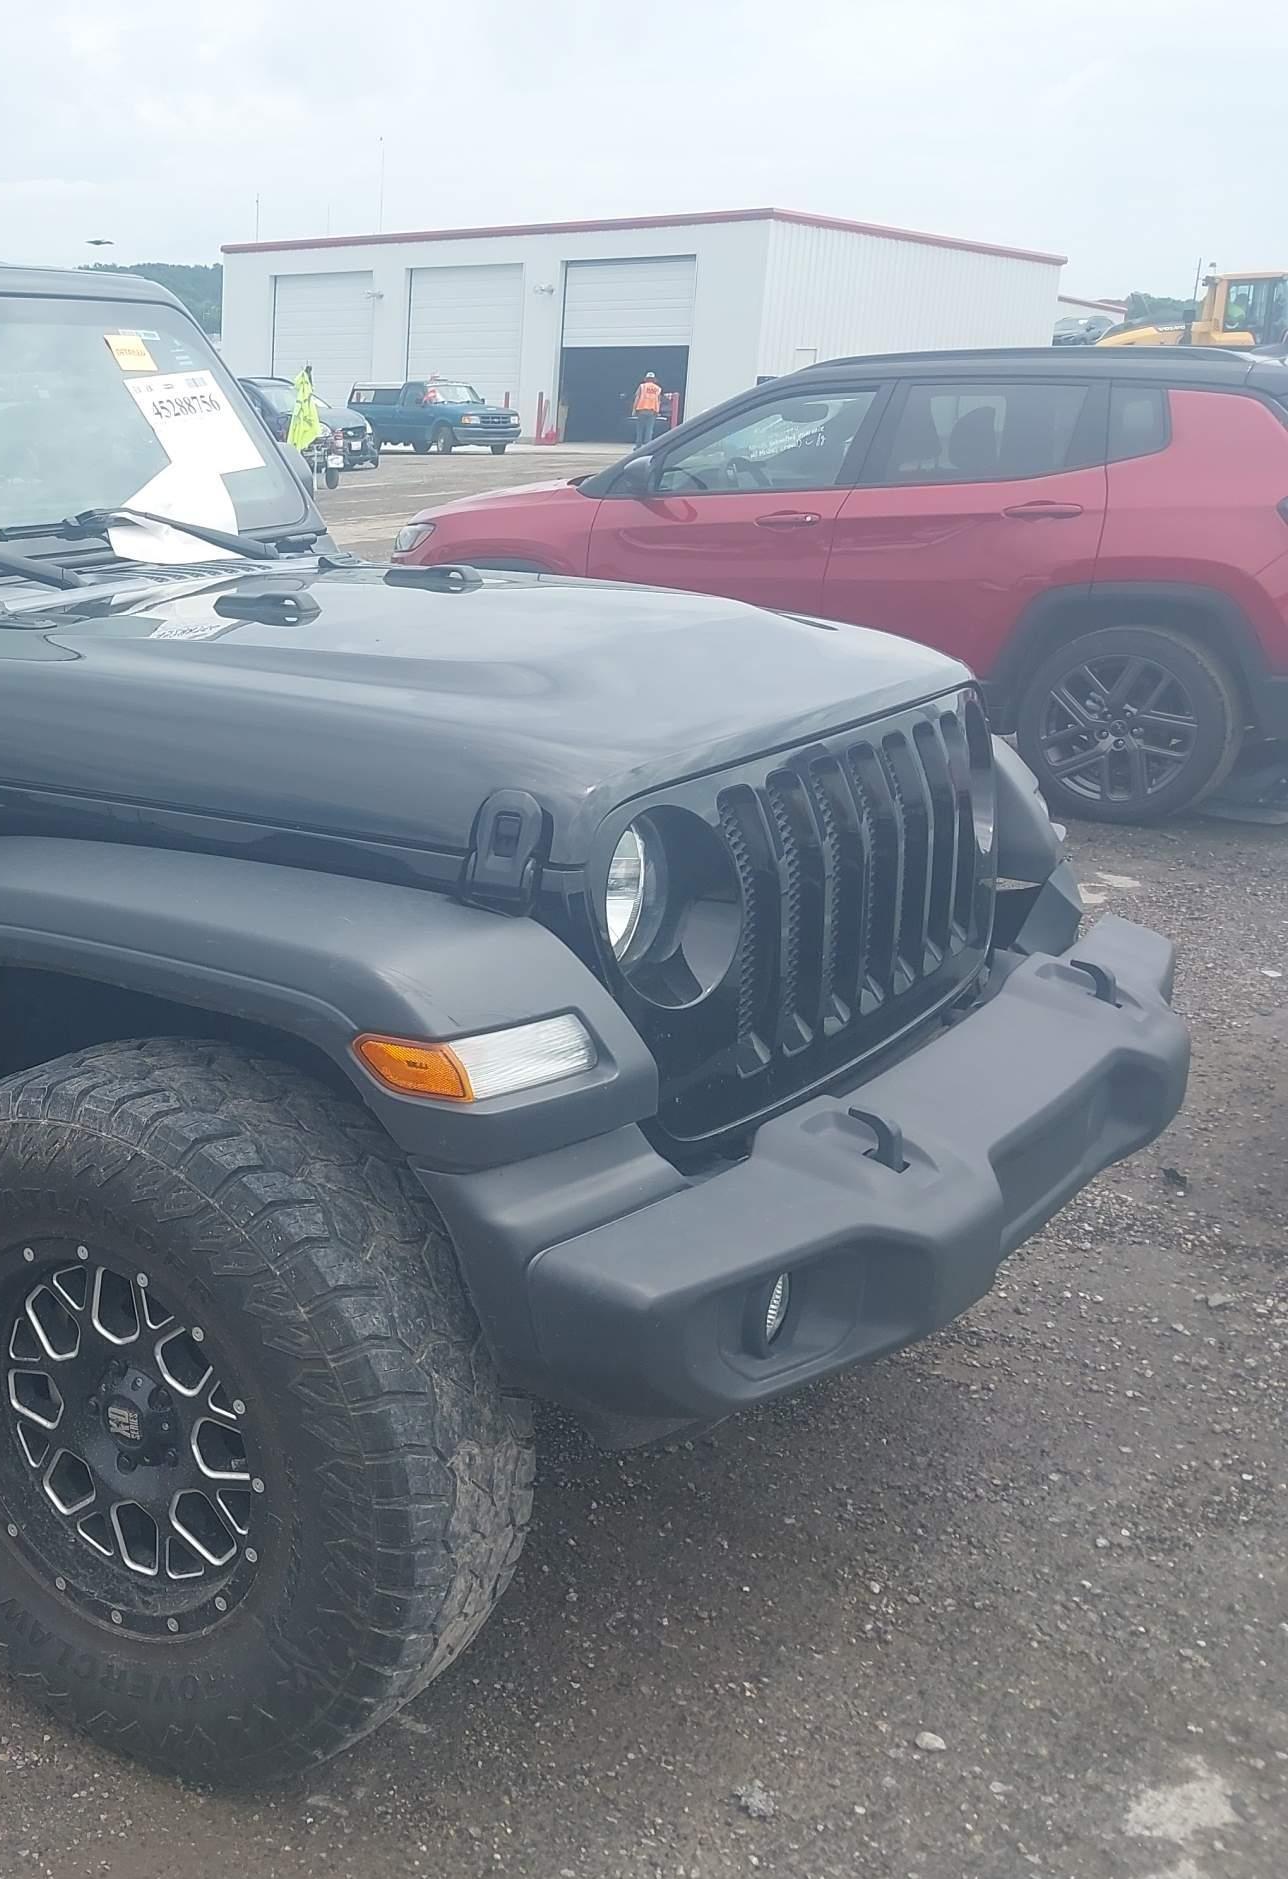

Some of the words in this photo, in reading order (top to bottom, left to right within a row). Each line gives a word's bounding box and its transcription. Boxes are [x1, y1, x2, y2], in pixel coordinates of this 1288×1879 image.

[152, 392, 221, 420] 45288756
[108, 1407, 130, 1438] XD
[128, 1412, 140, 1440] SERIES
